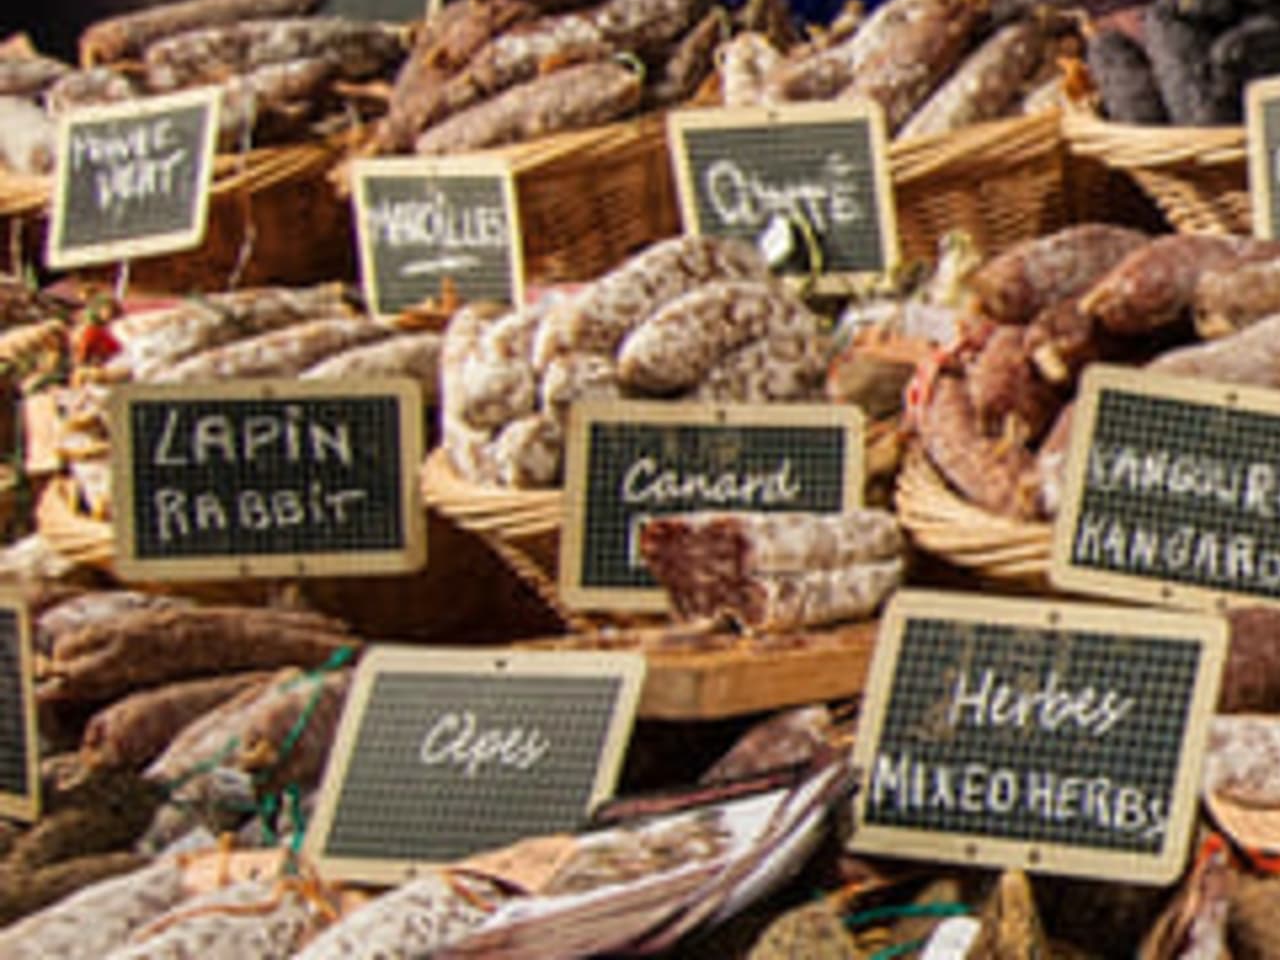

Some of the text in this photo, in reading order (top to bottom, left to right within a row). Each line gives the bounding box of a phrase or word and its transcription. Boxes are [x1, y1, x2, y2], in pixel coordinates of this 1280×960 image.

[623, 456, 800, 504] Canard
[949, 667, 1135, 738] Herbes
[870, 756, 1168, 839] MIXED HERBS
